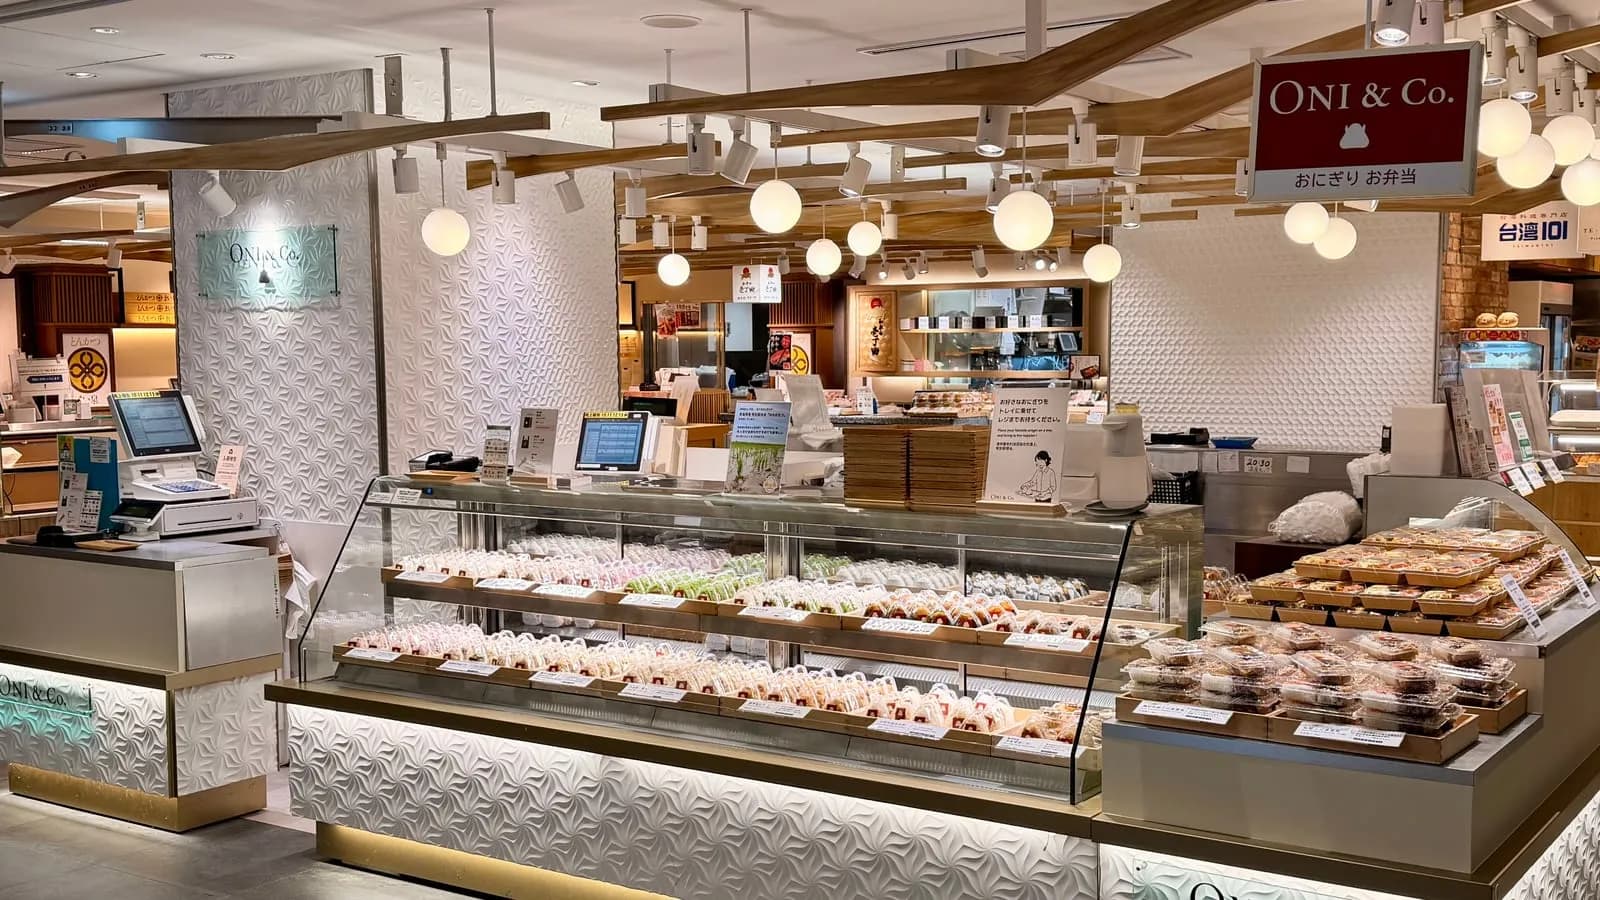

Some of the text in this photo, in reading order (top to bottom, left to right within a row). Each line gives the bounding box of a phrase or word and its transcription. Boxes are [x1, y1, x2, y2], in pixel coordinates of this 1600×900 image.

[1361, 82, 1391, 108] &
[1401, 78, 1455, 105] Co.
[1295, 168, 1416, 189] おにぎり お弁当
[1499, 220, 1568, 242] 台湾101
[32, 685, 46, 702] &
